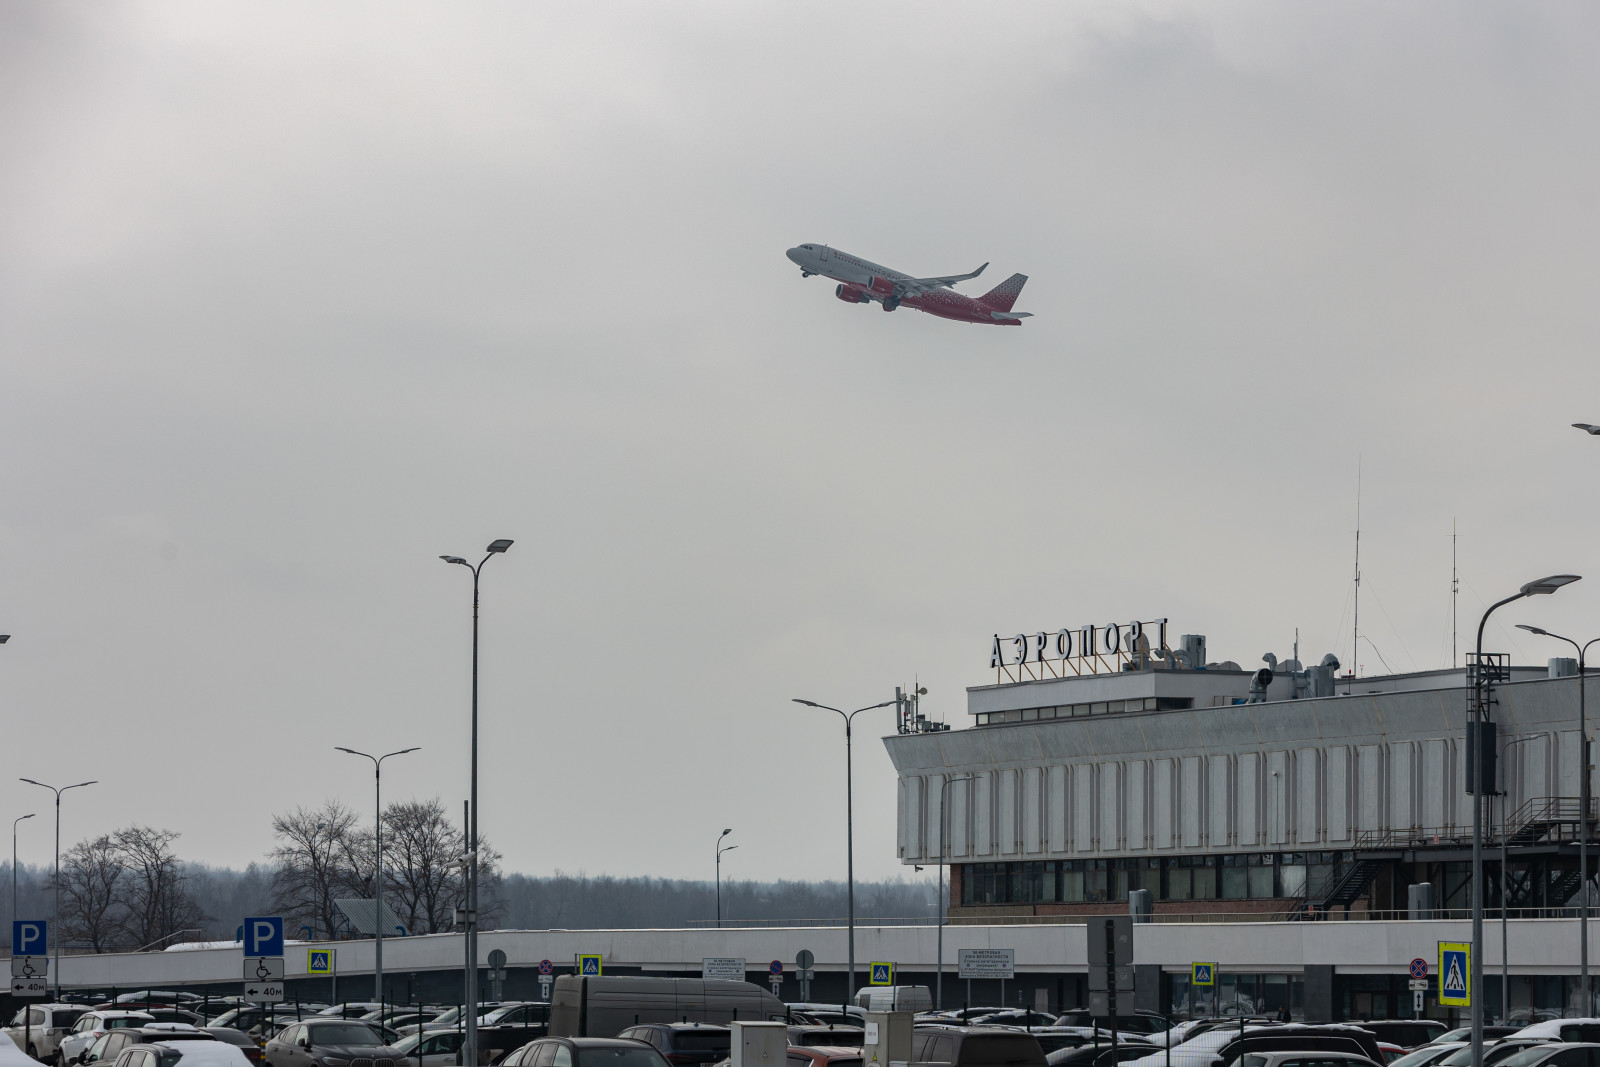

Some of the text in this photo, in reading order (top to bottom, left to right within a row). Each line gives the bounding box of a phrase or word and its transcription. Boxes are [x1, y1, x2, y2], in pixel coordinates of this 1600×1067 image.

[990, 617, 1168, 668] АЭРОПОРТ
[21, 924, 40, 952] P
[253, 921, 275, 952] P
